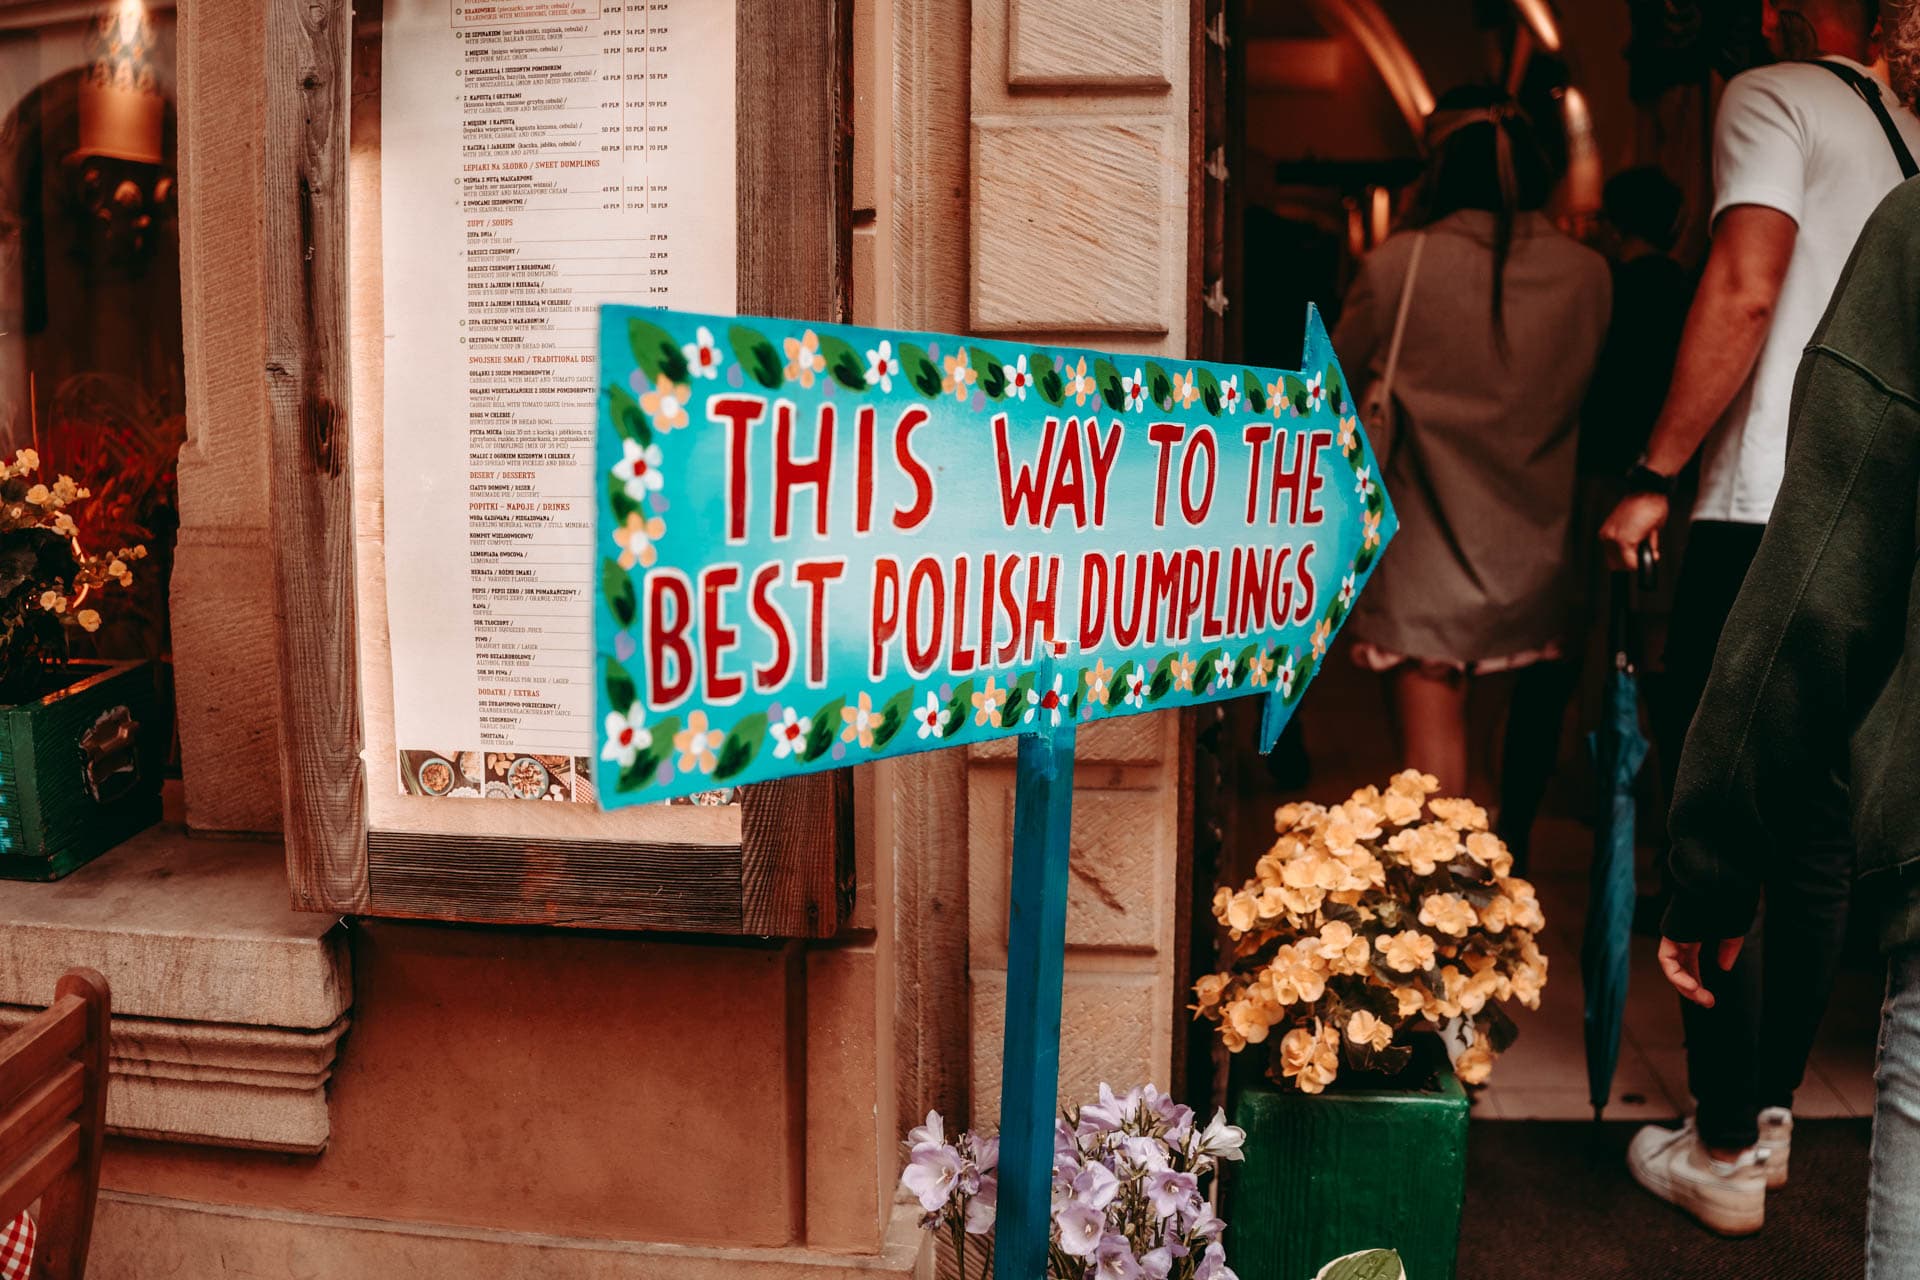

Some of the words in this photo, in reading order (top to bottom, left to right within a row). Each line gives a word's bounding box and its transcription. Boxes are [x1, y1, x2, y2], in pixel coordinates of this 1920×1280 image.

[706, 393, 934, 544] THIS
[992, 413, 1123, 533] WAY
[1148, 422, 1218, 531] TO
[1243, 423, 1333, 528] THE
[644, 558, 846, 714] BEST
[867, 550, 1066, 682] POLISH
[1079, 542, 1316, 658] DUMPLINGS
